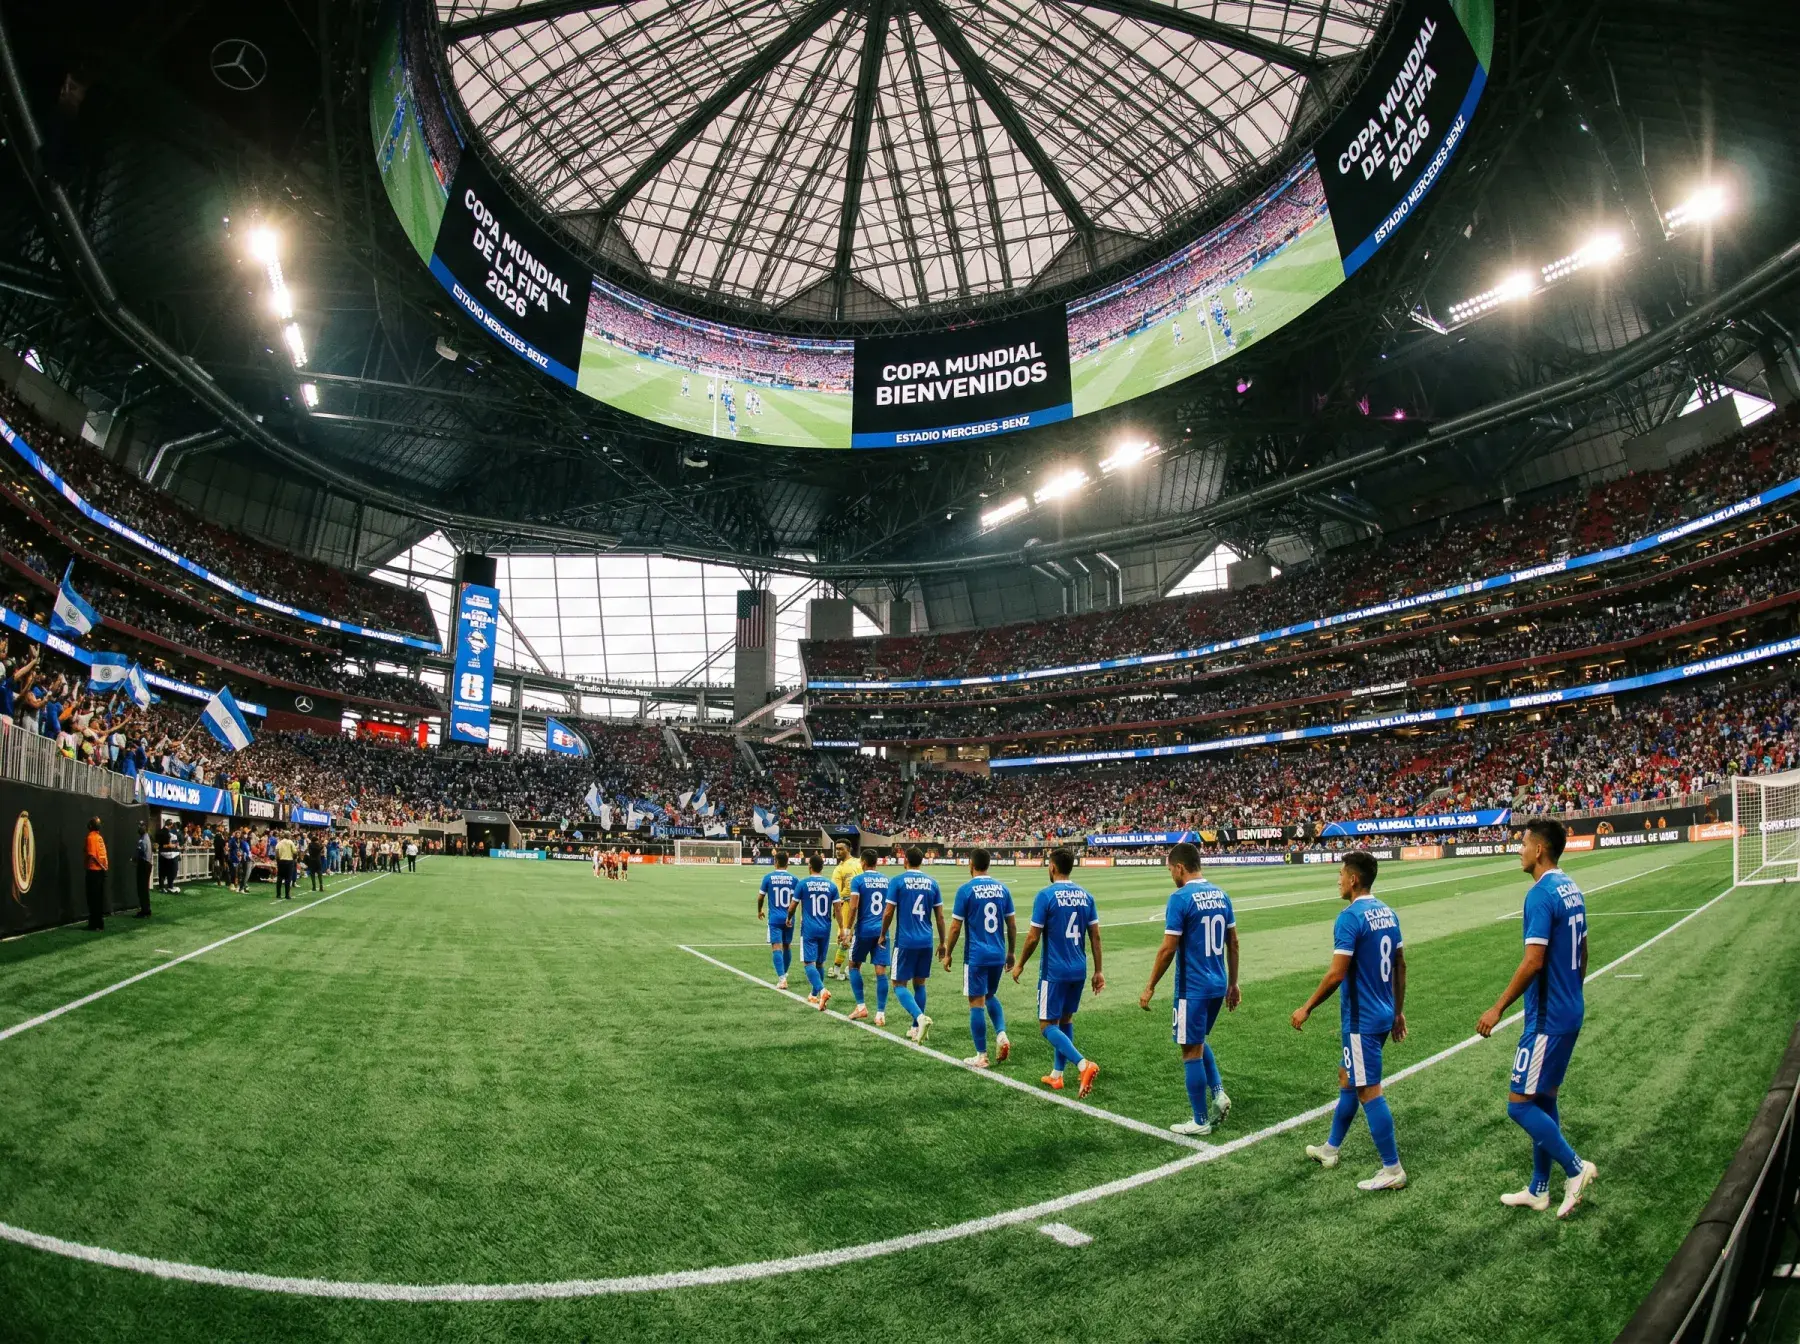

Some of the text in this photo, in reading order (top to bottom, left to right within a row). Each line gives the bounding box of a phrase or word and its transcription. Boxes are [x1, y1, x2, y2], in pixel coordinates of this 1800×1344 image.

[1338, 17, 1437, 175] COPA MUNDIAL
[1360, 64, 1438, 181] DE LA FIFA
[1389, 114, 1430, 181] 2026
[1374, 114, 1466, 244] ESTADIO MERCEDES-BENZ
[464, 189, 571, 304] COPA MUNDIAL
[472, 227, 550, 312] DE LA FIFA
[485, 271, 527, 318] 2026
[483, 314, 549, 368] MERCEDES-BENZ
[882, 341, 1042, 382] COPA MUNDIAL
[876, 362, 1048, 406] BIENVENIDOS
[896, 415, 1030, 444] ESTADIO MERCEDES-BENZ
[1426, 817, 1438, 827] LA
[772, 886, 791, 908] 10
[809, 893, 829, 917] 10
[870, 891, 883, 916] 8
[911, 893, 926, 922] 4
[983, 901, 999, 934] 8
[1065, 911, 1081, 946] 4
[1200, 914, 1226, 957] 10
[1380, 934, 1392, 983] 8
[1343, 1046, 1351, 1069] 8
